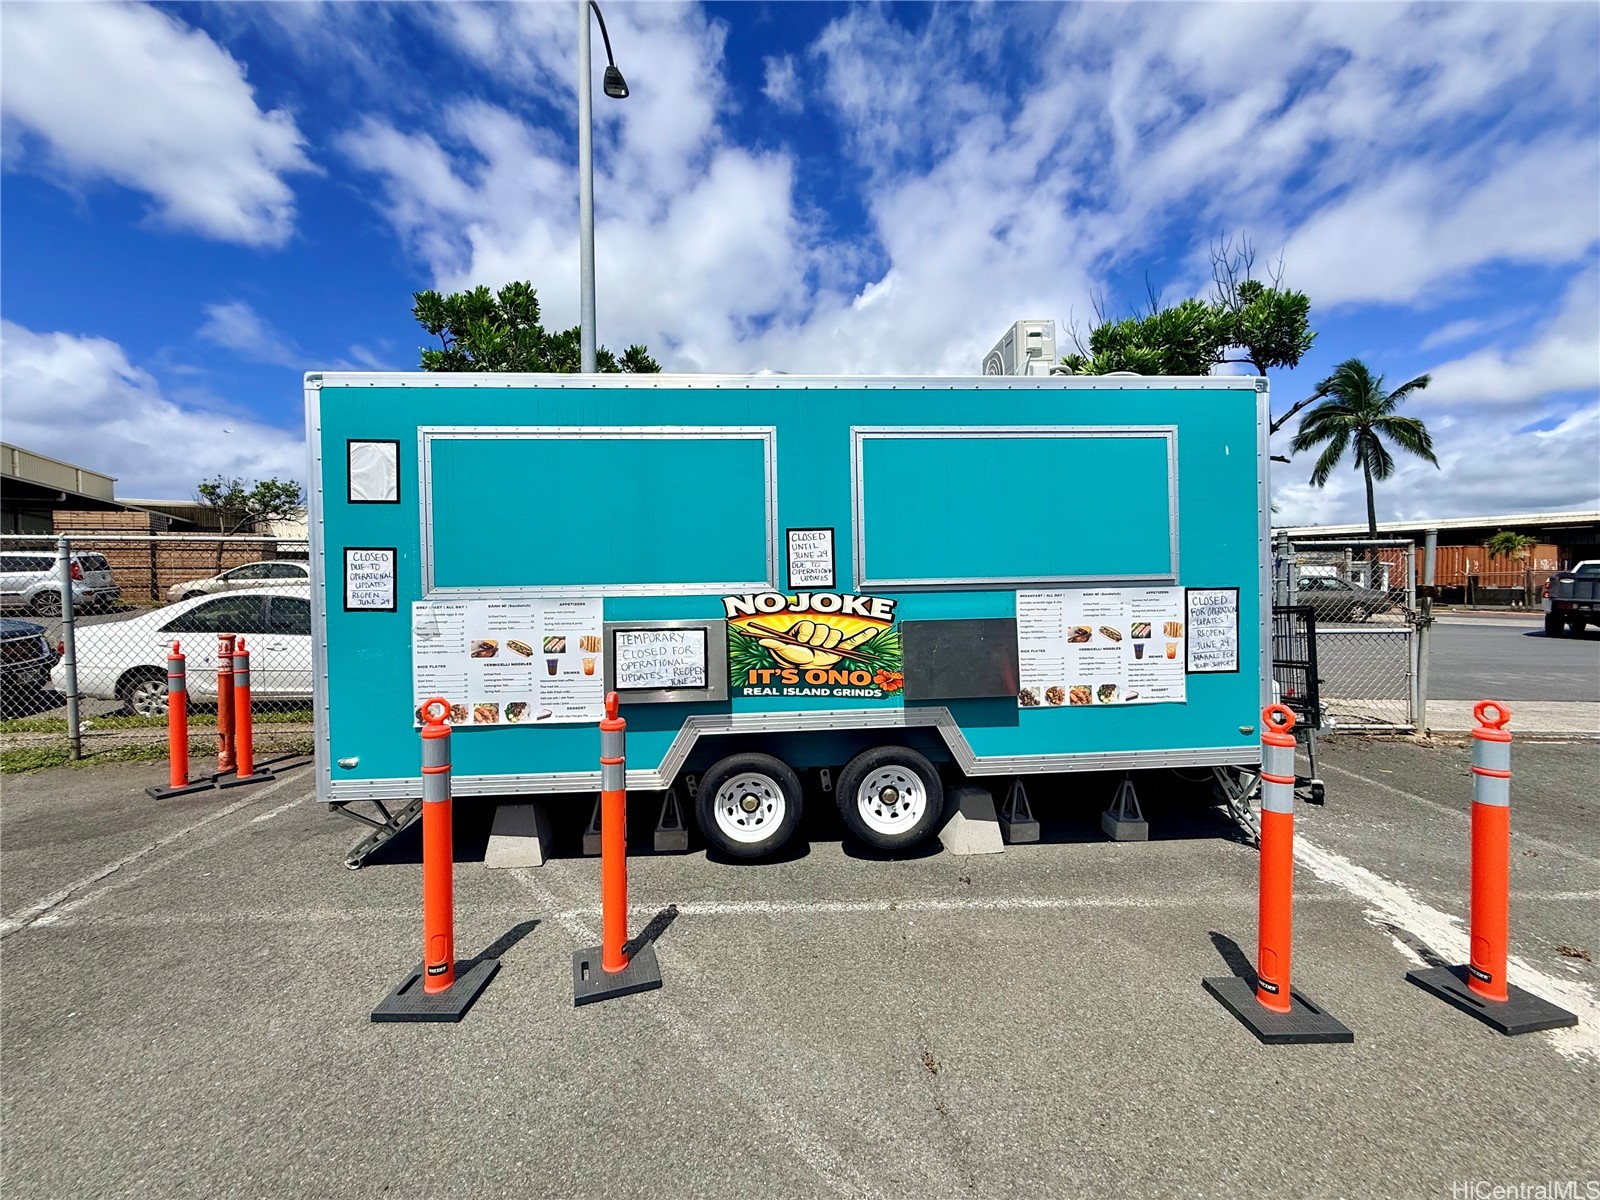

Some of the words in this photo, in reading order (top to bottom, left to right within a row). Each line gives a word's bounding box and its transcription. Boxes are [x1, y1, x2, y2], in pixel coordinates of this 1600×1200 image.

[792, 532, 826, 542] CLOSED
[792, 542, 819, 551] UNTIL
[352, 552, 389, 562] CLOSED
[793, 552, 815, 560] JUNE
[350, 572, 394, 581] OPERATIONAL
[1192, 596, 1228, 606] CLOSED
[722, 592, 786, 619] NO
[787, 592, 895, 623] JOKE
[1190, 608, 1206, 616] FOR
[619, 632, 686, 645] TEMPORARY
[1197, 629, 1225, 638] REOPEN
[1196, 641, 1216, 650] JUNE
[622, 646, 667, 660] CLOSED
[672, 645, 694, 655] FOR
[621, 658, 689, 672] OPERATIONAL
[672, 666, 706, 677] REOPEN
[668, 678, 688, 686] JUNE
[748, 669, 800, 685] IT'S
[804, 670, 872, 686] ONO
[744, 688, 780, 696] REAL
[784, 688, 830, 696] ISLAND
[832, 688, 882, 697] GRINDS
